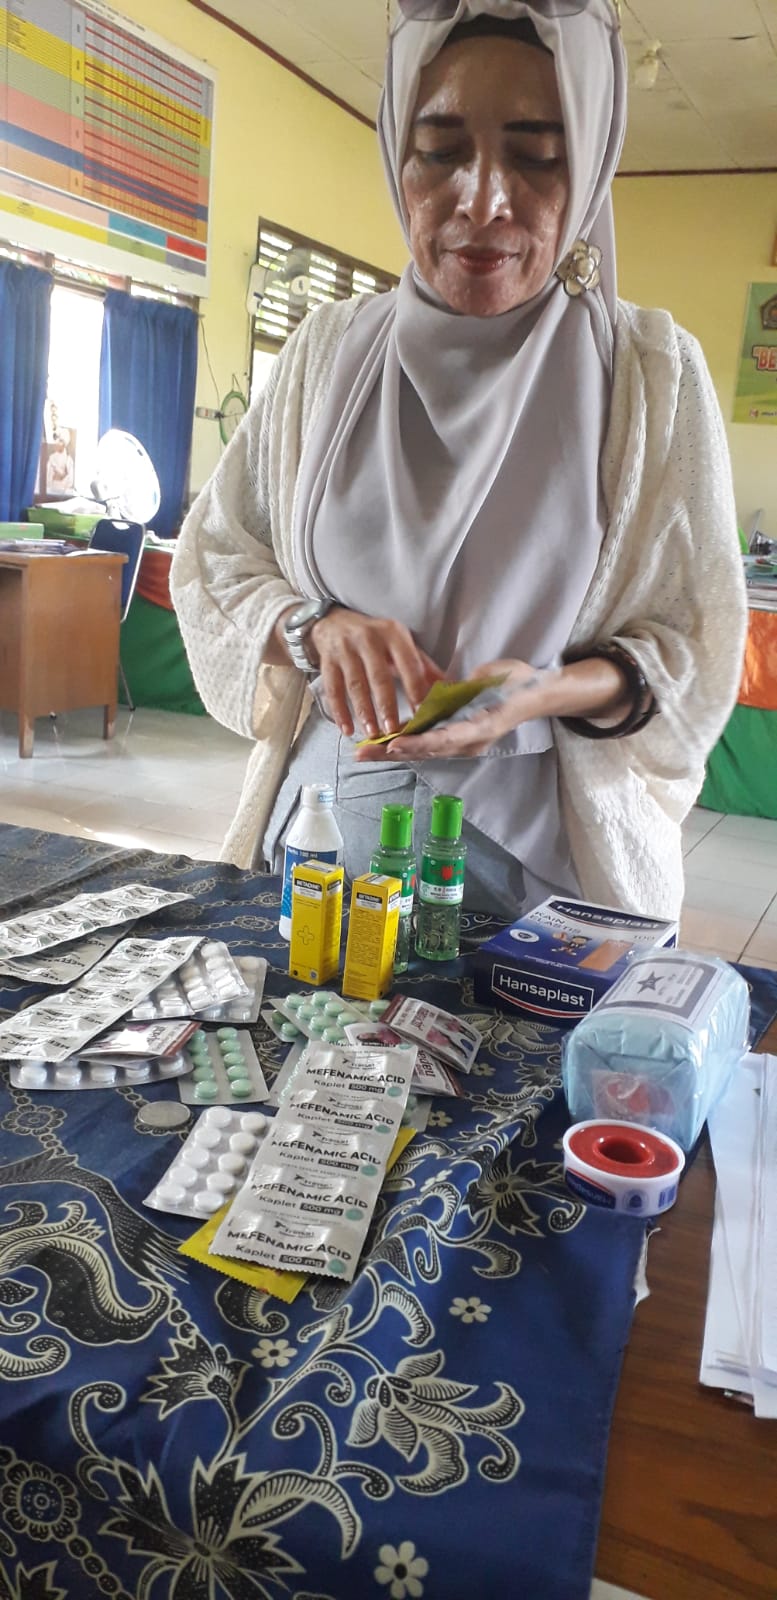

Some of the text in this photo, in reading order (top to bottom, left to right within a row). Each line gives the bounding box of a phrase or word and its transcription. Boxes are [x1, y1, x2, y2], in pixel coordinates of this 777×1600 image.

[534, 911, 566, 925] KAIN
[556, 904, 660, 929] Hansaplast
[499, 974, 585, 1008] Hansaplast
[306, 1068, 406, 1084] MEFENAMIC ACID
[314, 1079, 345, 1088] Kaplet
[289, 1102, 361, 1121] MEFENAMIC
[365, 1112, 394, 1125] ACID
[297, 1113, 330, 1123] Kaplet
[271, 1140, 347, 1158] MEFENAMIC
[350, 1151, 382, 1165] ACID
[280, 1151, 314, 1163] Kaplet
[340, 1162, 358, 1171] mg
[251, 1183, 332, 1203] MEFENAMIC
[334, 1195, 368, 1209] ACID
[259, 1195, 297, 1208] Kaplet
[302, 1203, 322, 1212] 500
[323, 1207, 342, 1216] mg
[227, 1231, 314, 1252] MEFENAMIC
[316, 1243, 352, 1260] ACID
[235, 1244, 324, 1268] Kaplet 500 mg
